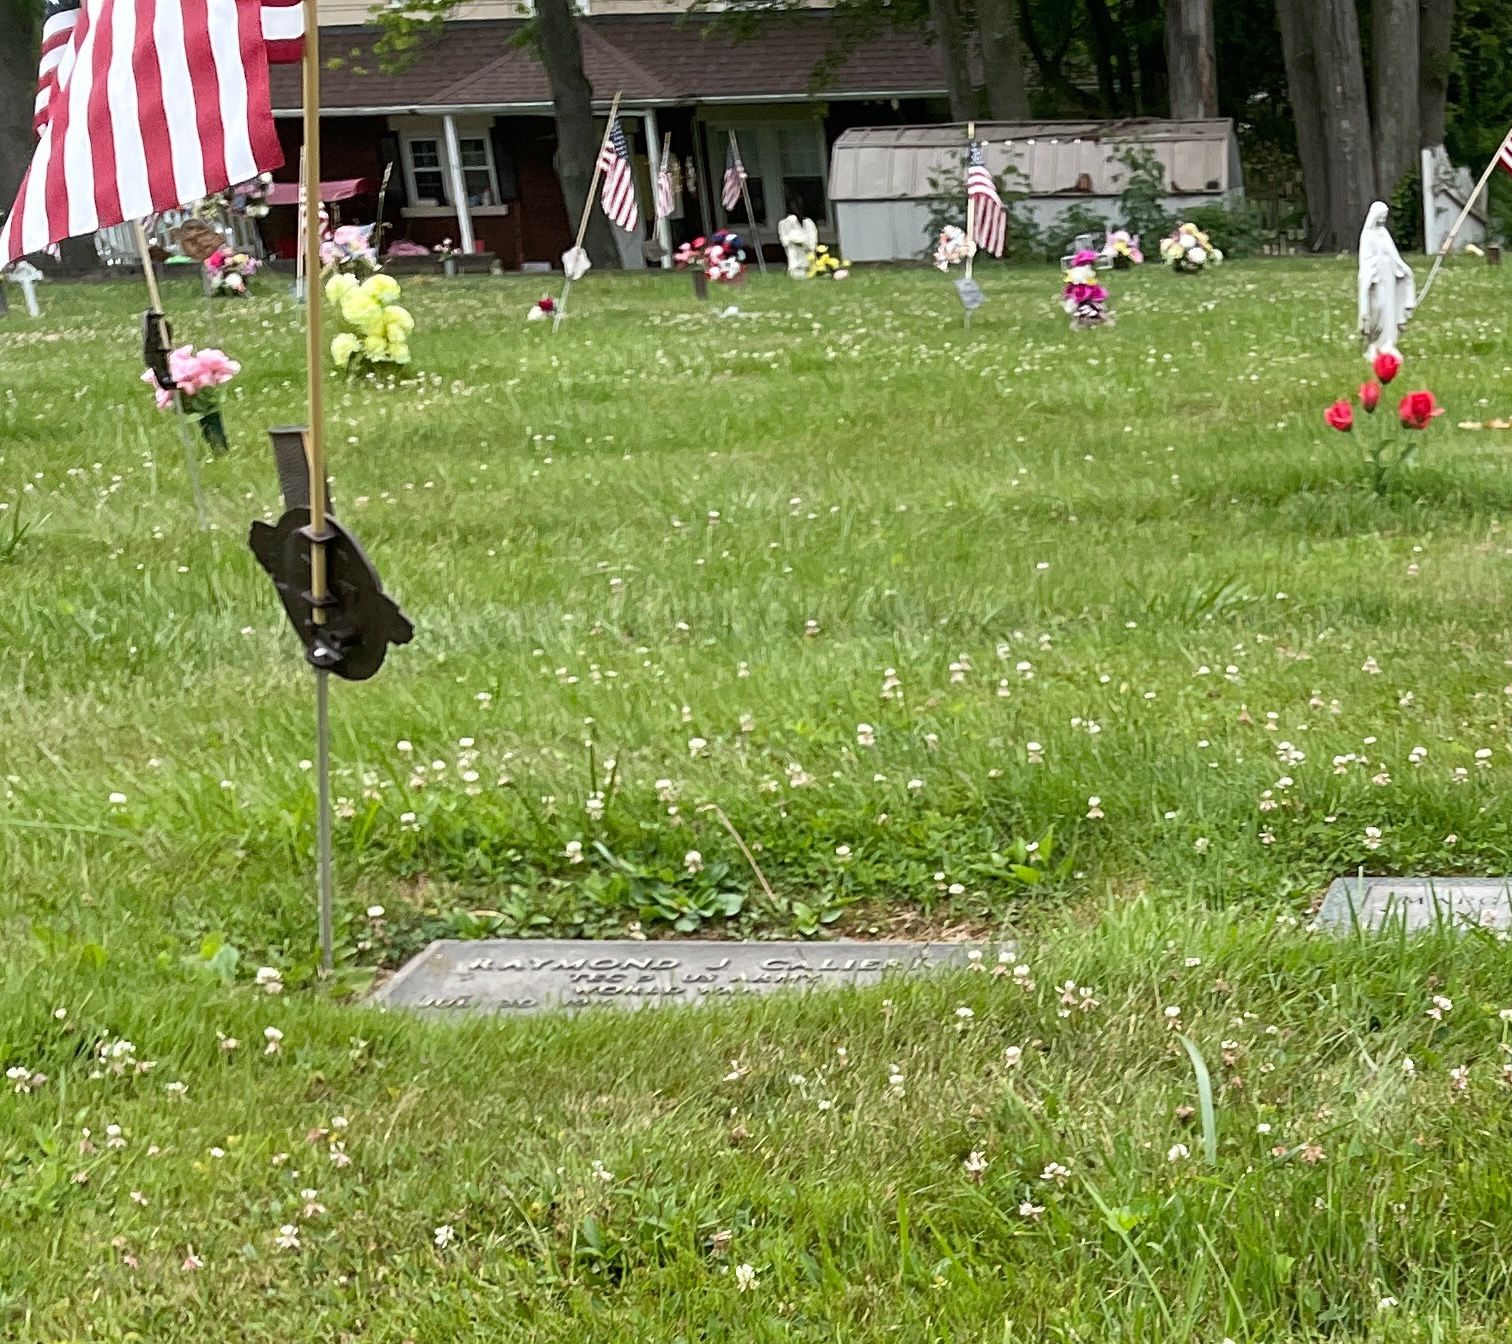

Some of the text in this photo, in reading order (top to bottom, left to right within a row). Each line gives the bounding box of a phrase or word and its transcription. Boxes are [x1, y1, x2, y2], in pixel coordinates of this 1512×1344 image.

[468, 956, 683, 972] RAYMOND
[705, 956, 731, 971] J
[574, 984, 688, 998] WORLD
